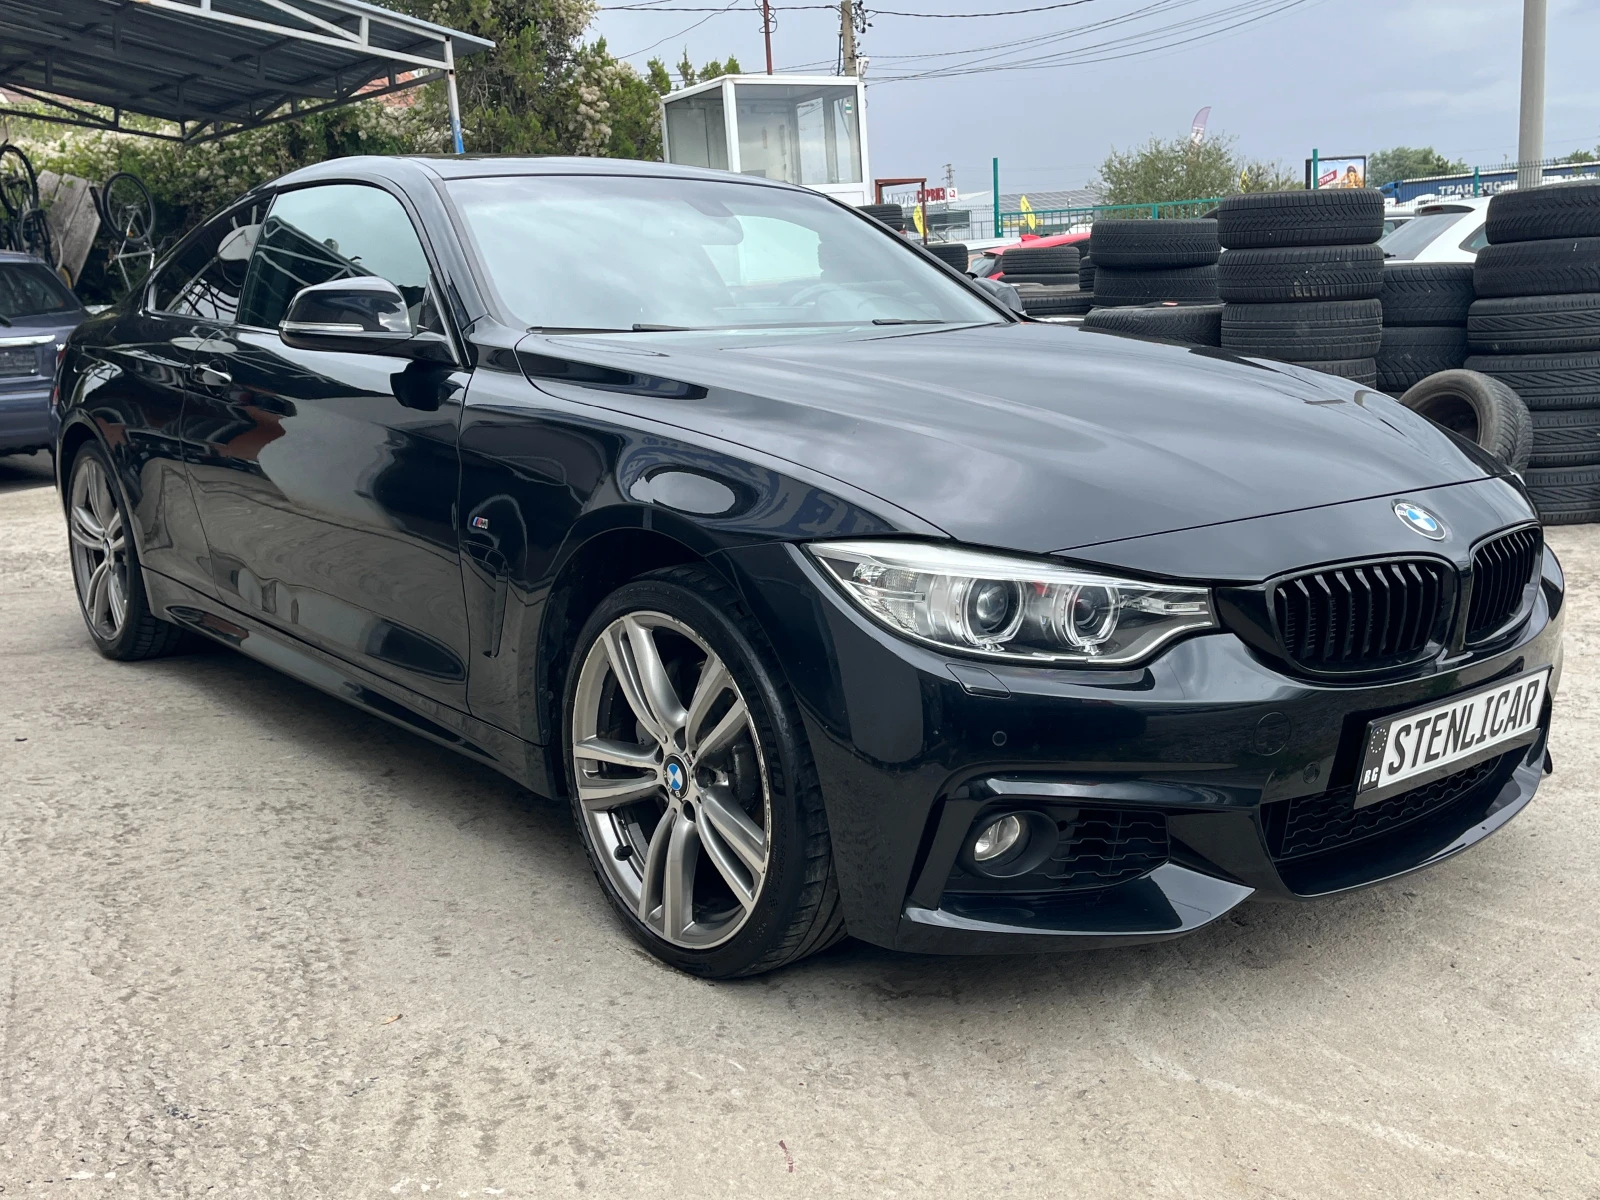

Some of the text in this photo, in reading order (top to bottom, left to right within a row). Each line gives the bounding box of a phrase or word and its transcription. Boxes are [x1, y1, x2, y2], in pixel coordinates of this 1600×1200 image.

[917, 187, 946, 204] СРВИЗ
[1387, 679, 1540, 776] STENLICAR
[1363, 766, 1379, 785] BG
